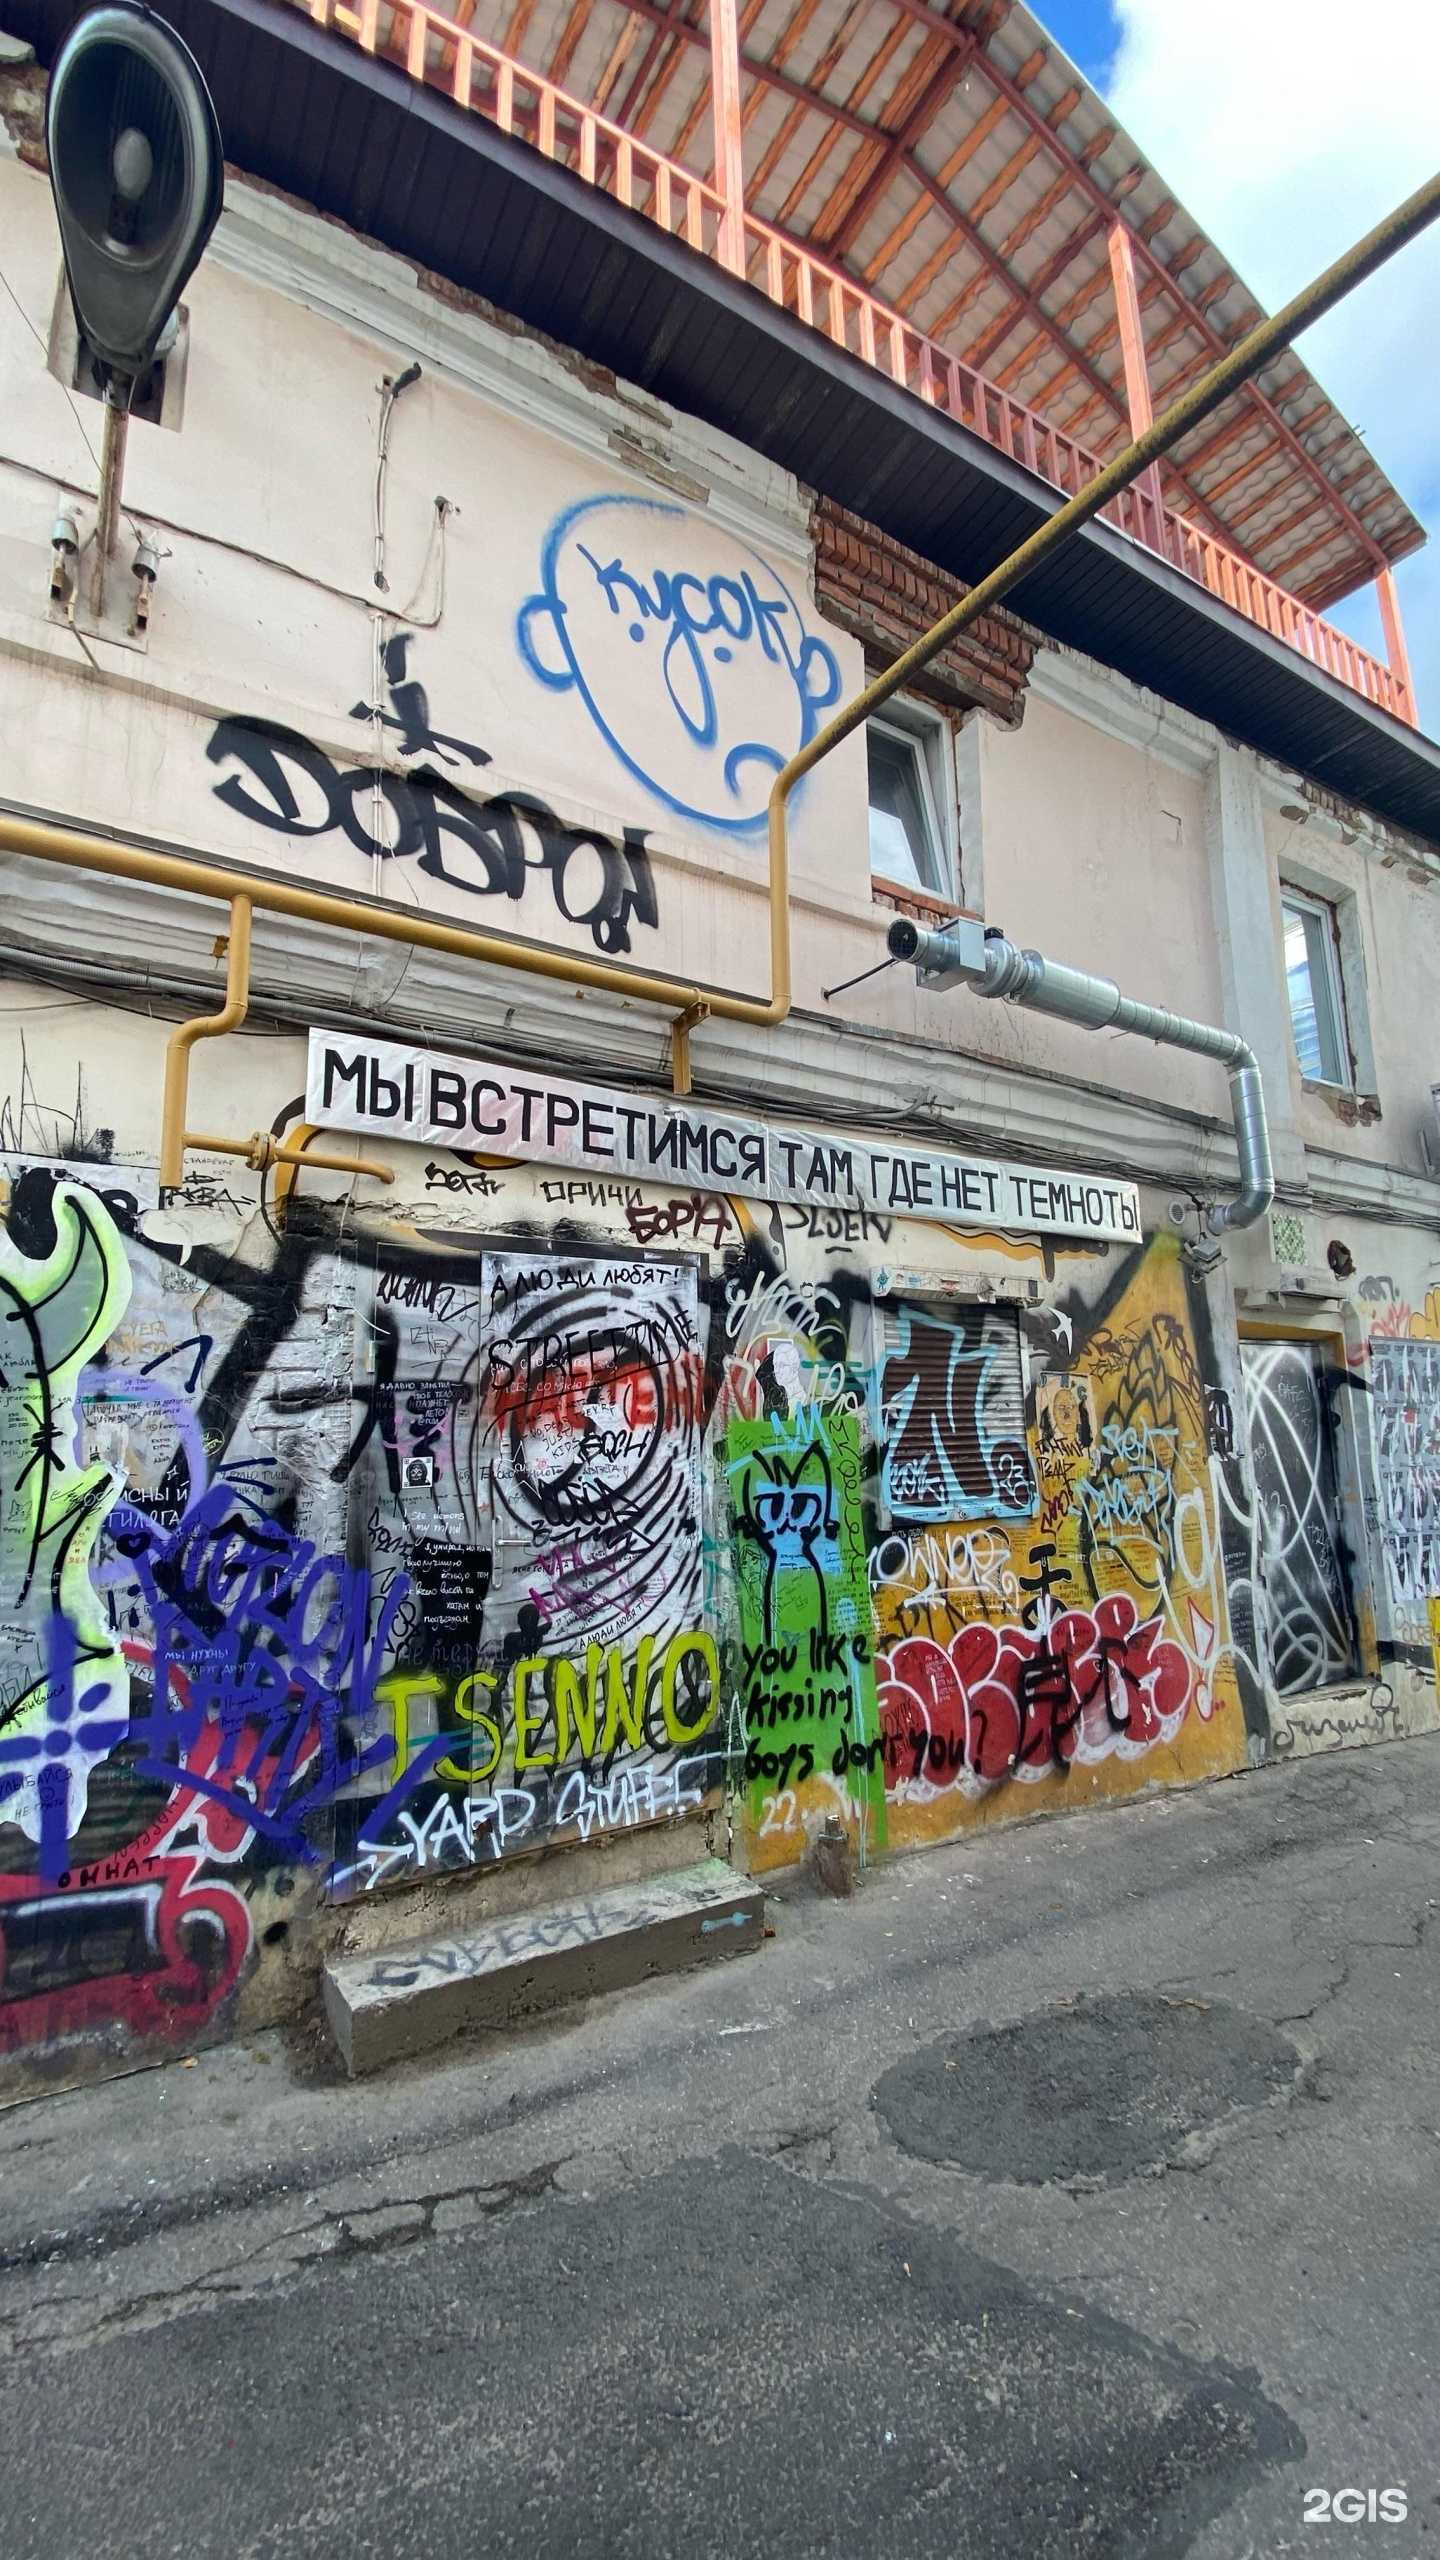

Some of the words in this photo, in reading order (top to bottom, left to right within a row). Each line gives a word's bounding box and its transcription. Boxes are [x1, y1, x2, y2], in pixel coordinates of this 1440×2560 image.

[322, 1048, 415, 1122] МЫ
[429, 1068, 767, 1186] ВСТРЕТИМСЯ
[779, 1140, 854, 1196] ТАМ
[870, 1154, 933, 1209] ГДЕ
[940, 1166, 999, 1213] НЕТ
[1009, 1175, 1141, 1232] ТЕМНОТЫ
